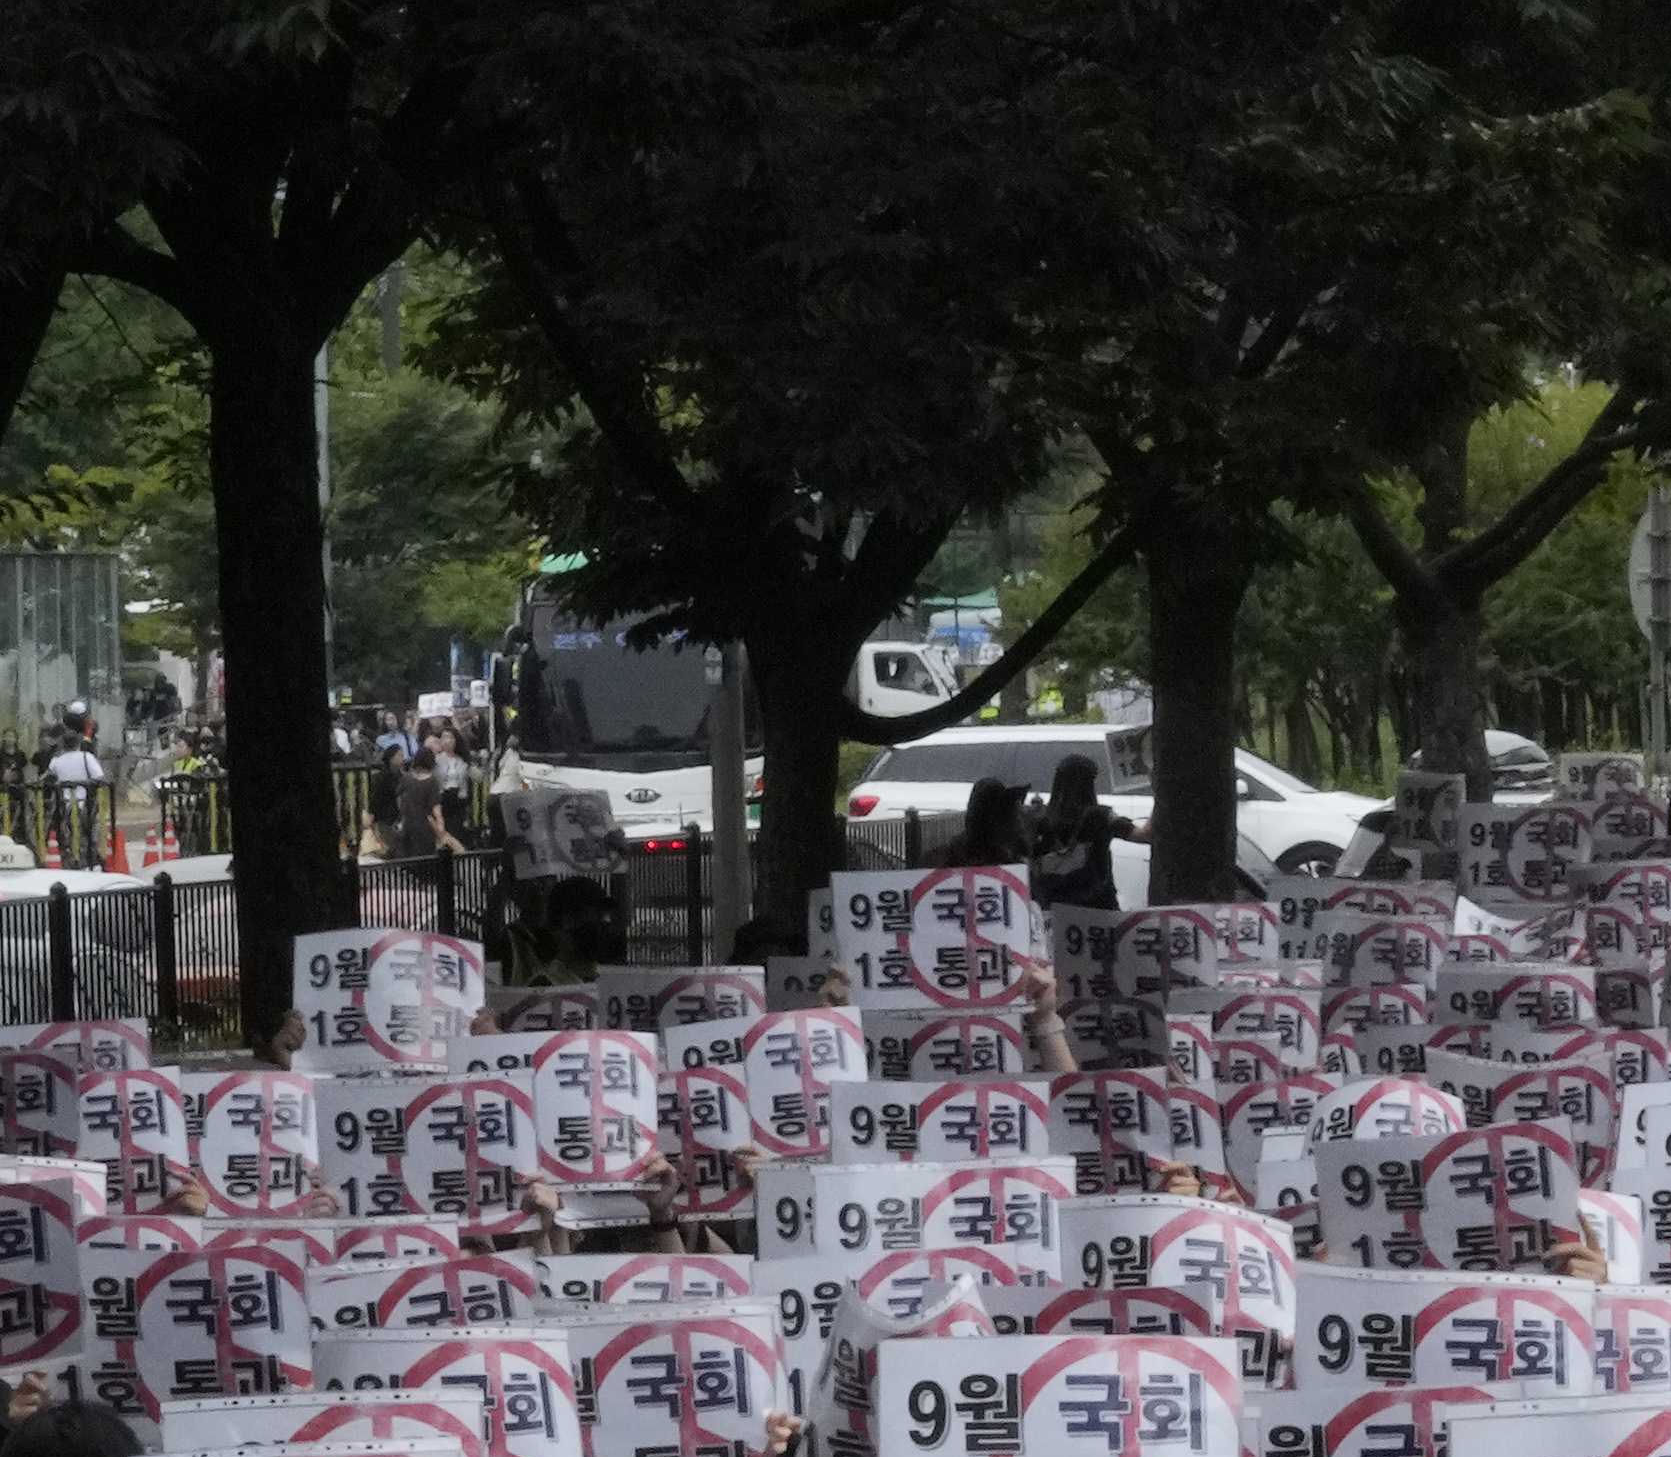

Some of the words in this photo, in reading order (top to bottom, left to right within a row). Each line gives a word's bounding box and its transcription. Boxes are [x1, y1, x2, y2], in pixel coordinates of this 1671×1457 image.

[848, 891, 911, 932] 9월
[933, 889, 1014, 932] 국회
[308, 948, 370, 988] 9월
[390, 952, 471, 995] 국회
[860, 951, 911, 988] 1호
[933, 945, 1012, 987] 통과
[311, 1008, 366, 1047] 1호
[391, 1000, 467, 1041] 통과
[906, 1373, 1025, 1454] 9월
[1059, 1373, 1205, 1453] 국회
